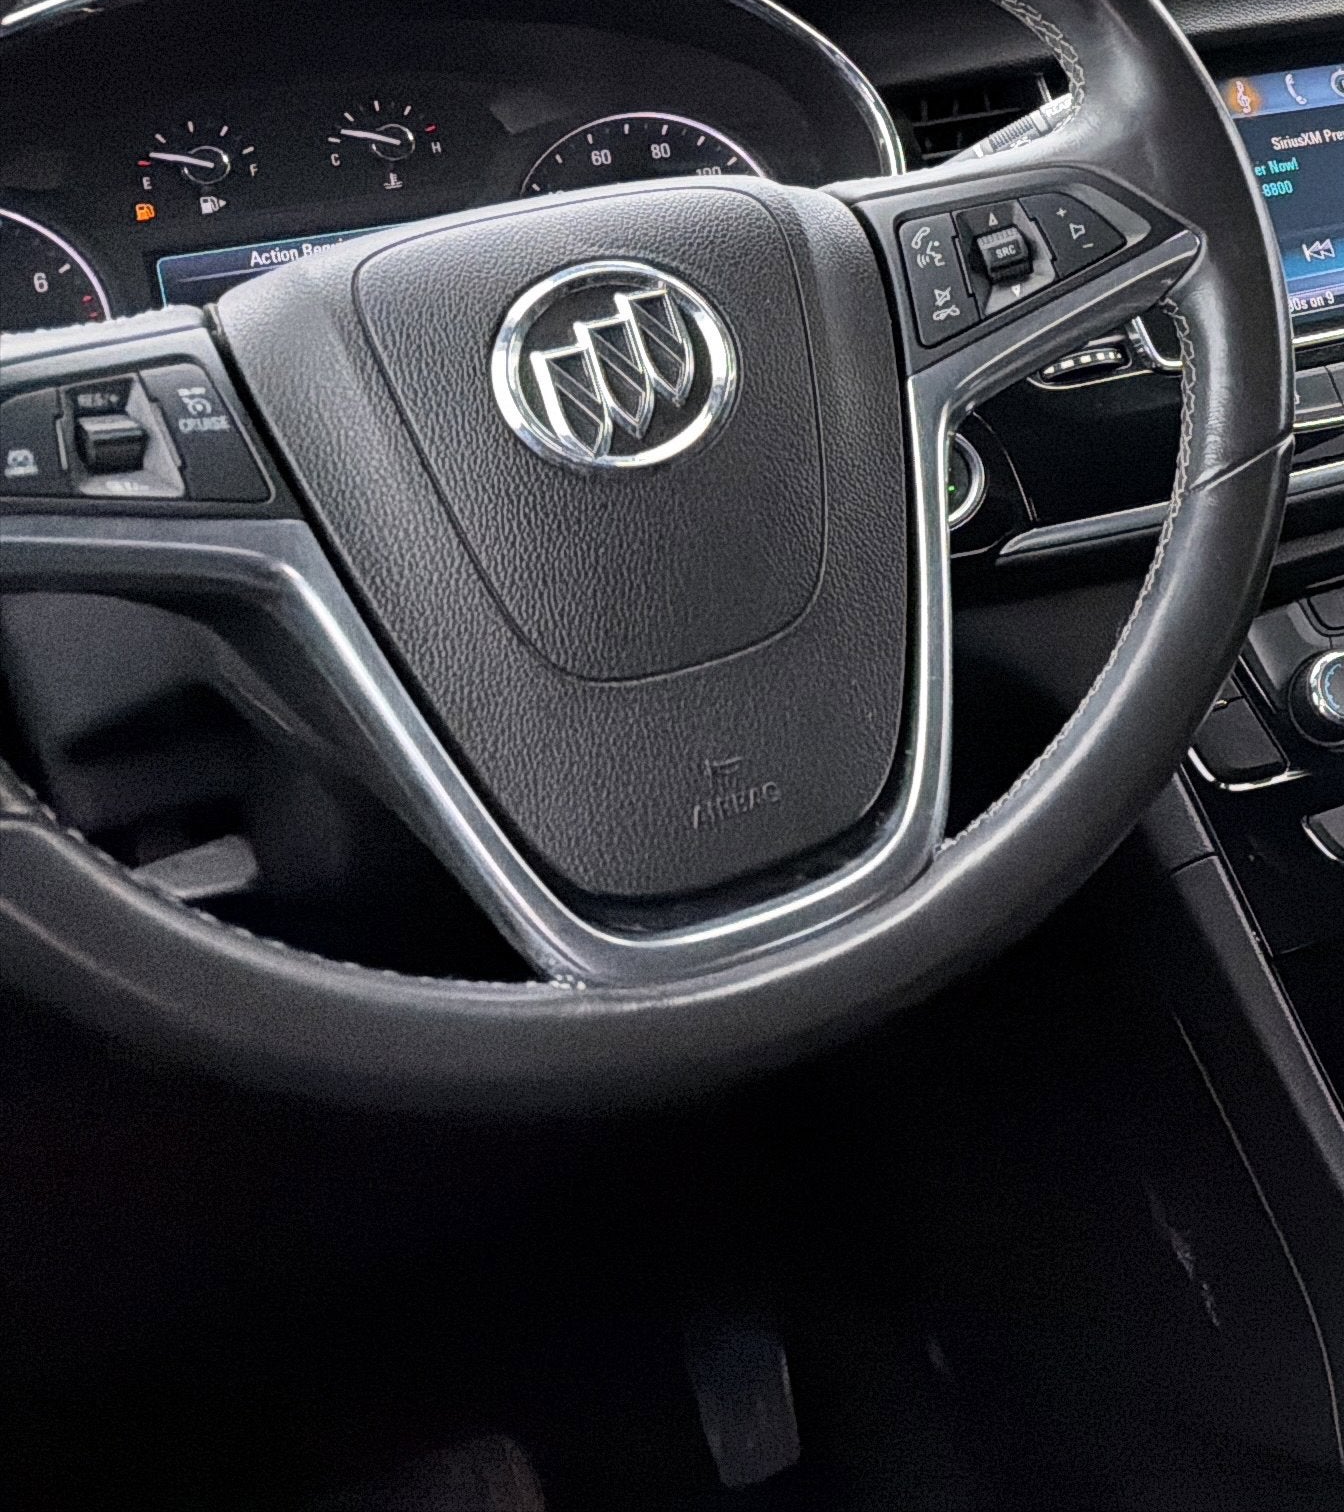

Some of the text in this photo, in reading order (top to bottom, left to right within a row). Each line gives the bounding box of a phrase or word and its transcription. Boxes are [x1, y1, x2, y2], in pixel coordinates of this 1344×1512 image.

[1270, 130, 1323, 151] SiriusXM
[591, 149, 612, 166] 60
[650, 143, 671, 159] 80
[1267, 157, 1299, 174] Now!
[142, 176, 152, 190] E
[250, 247, 299, 268] Action
[995, 244, 1017, 259] SRC
[33, 272, 49, 293] 6
[1309, 296, 1325, 308] on
[1325, 290, 1335, 305] 9
